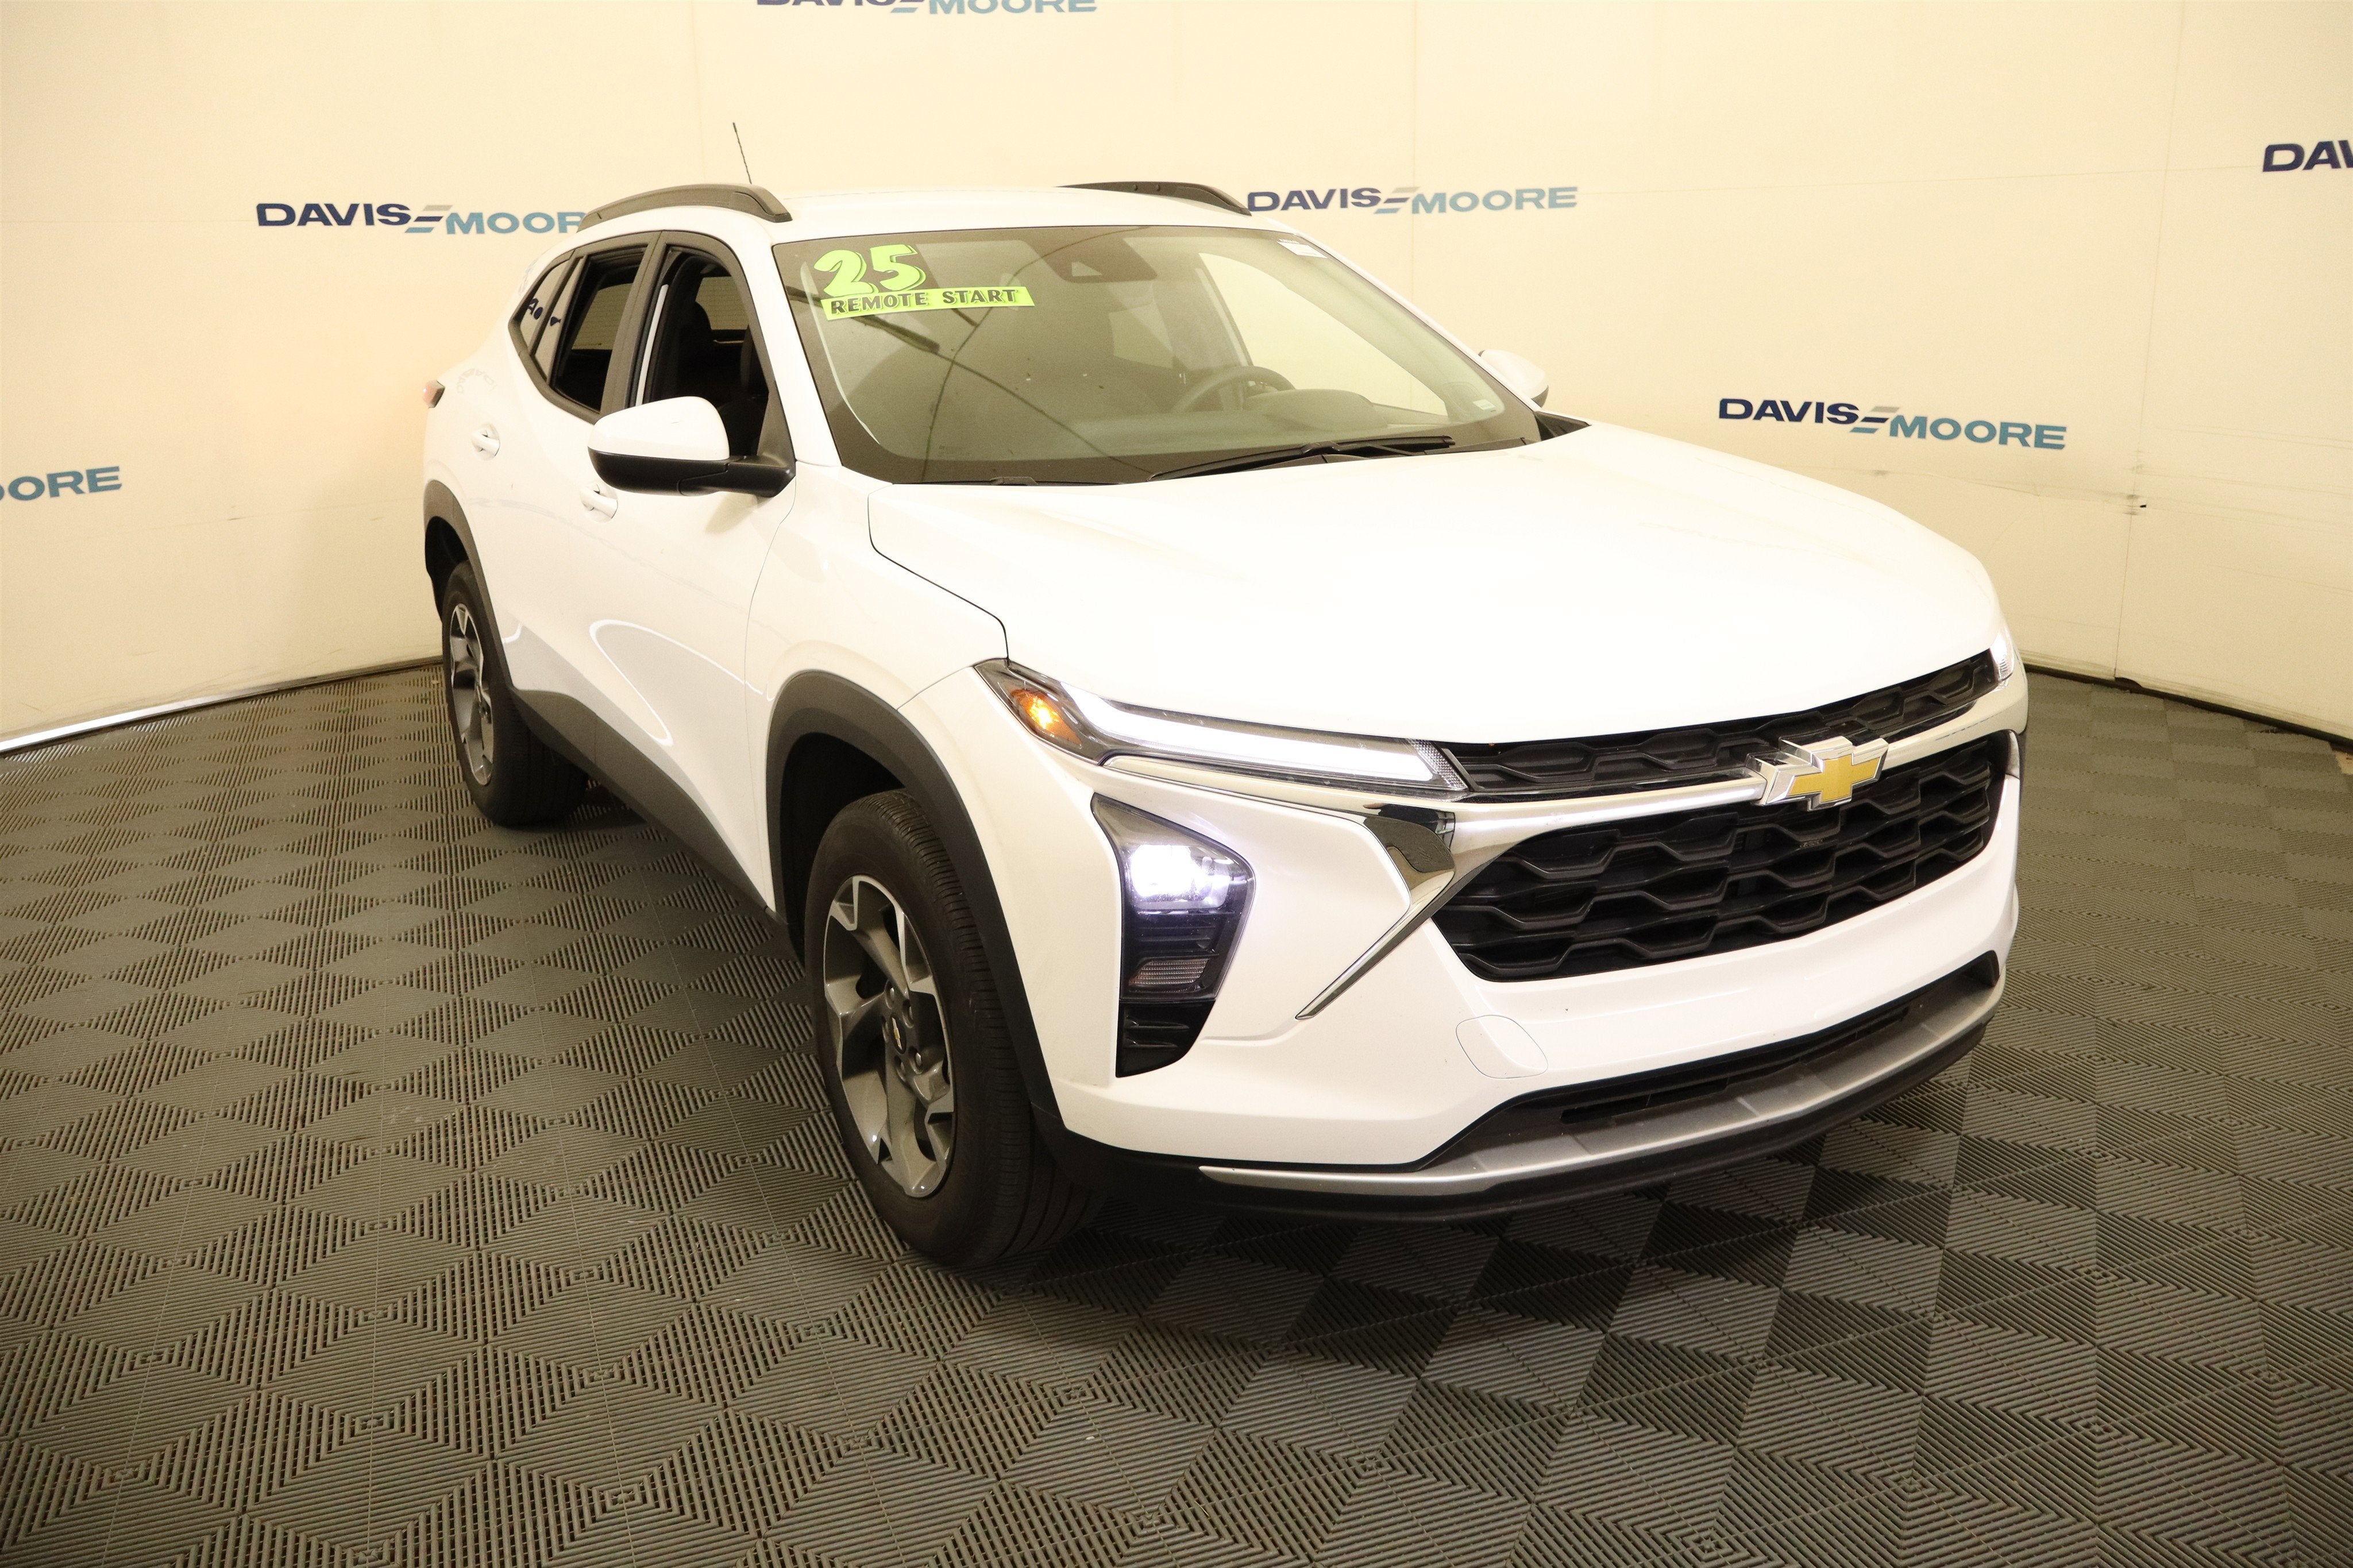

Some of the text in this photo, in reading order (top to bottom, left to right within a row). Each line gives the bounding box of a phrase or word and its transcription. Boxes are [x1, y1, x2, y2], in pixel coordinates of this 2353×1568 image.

[1247, 186, 1578, 214] DAVIS MOORE
[256, 203, 586, 234] DAVIS MOOR
[813, 244, 927, 298] 25
[831, 288, 1019, 315] REMOTE START
[1718, 398, 2067, 450] DAVIS MOORE
[0, 466, 122, 501] ORE
